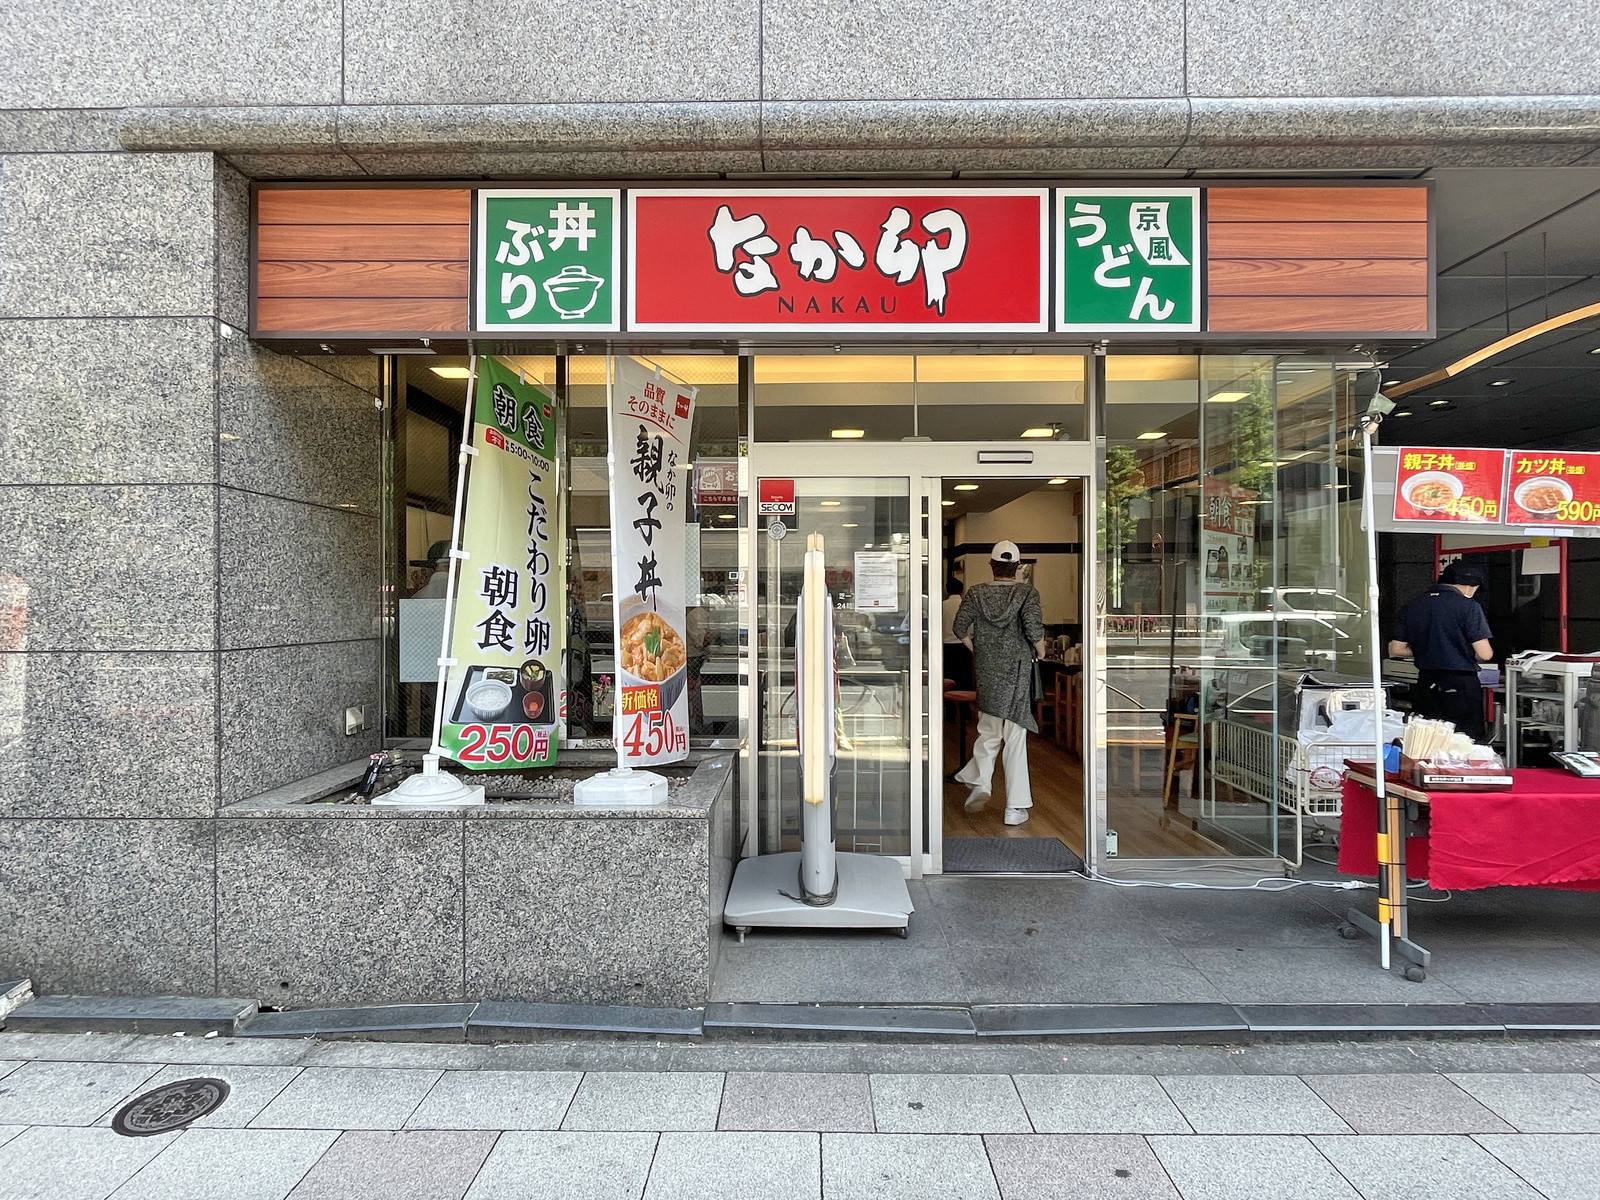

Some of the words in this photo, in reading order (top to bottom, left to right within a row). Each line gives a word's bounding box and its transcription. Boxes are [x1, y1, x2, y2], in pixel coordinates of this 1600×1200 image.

[1136, 206, 1173, 261] 京風
[708, 204, 968, 317] なか卯
[1069, 202, 1176, 321] うどん
[778, 296, 897, 313] NAKAU
[493, 385, 545, 450] 朝食
[628, 395, 676, 430] そのままに
[665, 450, 678, 512] なか卯の
[1403, 453, 1455, 471] 親子丼
[1516, 457, 1566, 475] カツ丼
[630, 424, 664, 613] 親子丼
[761, 503, 793, 512] SECOM
[1209, 493, 1232, 529] 朝食
[1445, 496, 1497, 518] 450円
[524, 468, 551, 656] こだわり卵
[477, 565, 519, 652] 朝食
[622, 688, 659, 711] 新価格
[458, 724, 549, 763] 250円
[623, 709, 687, 758] 450円
